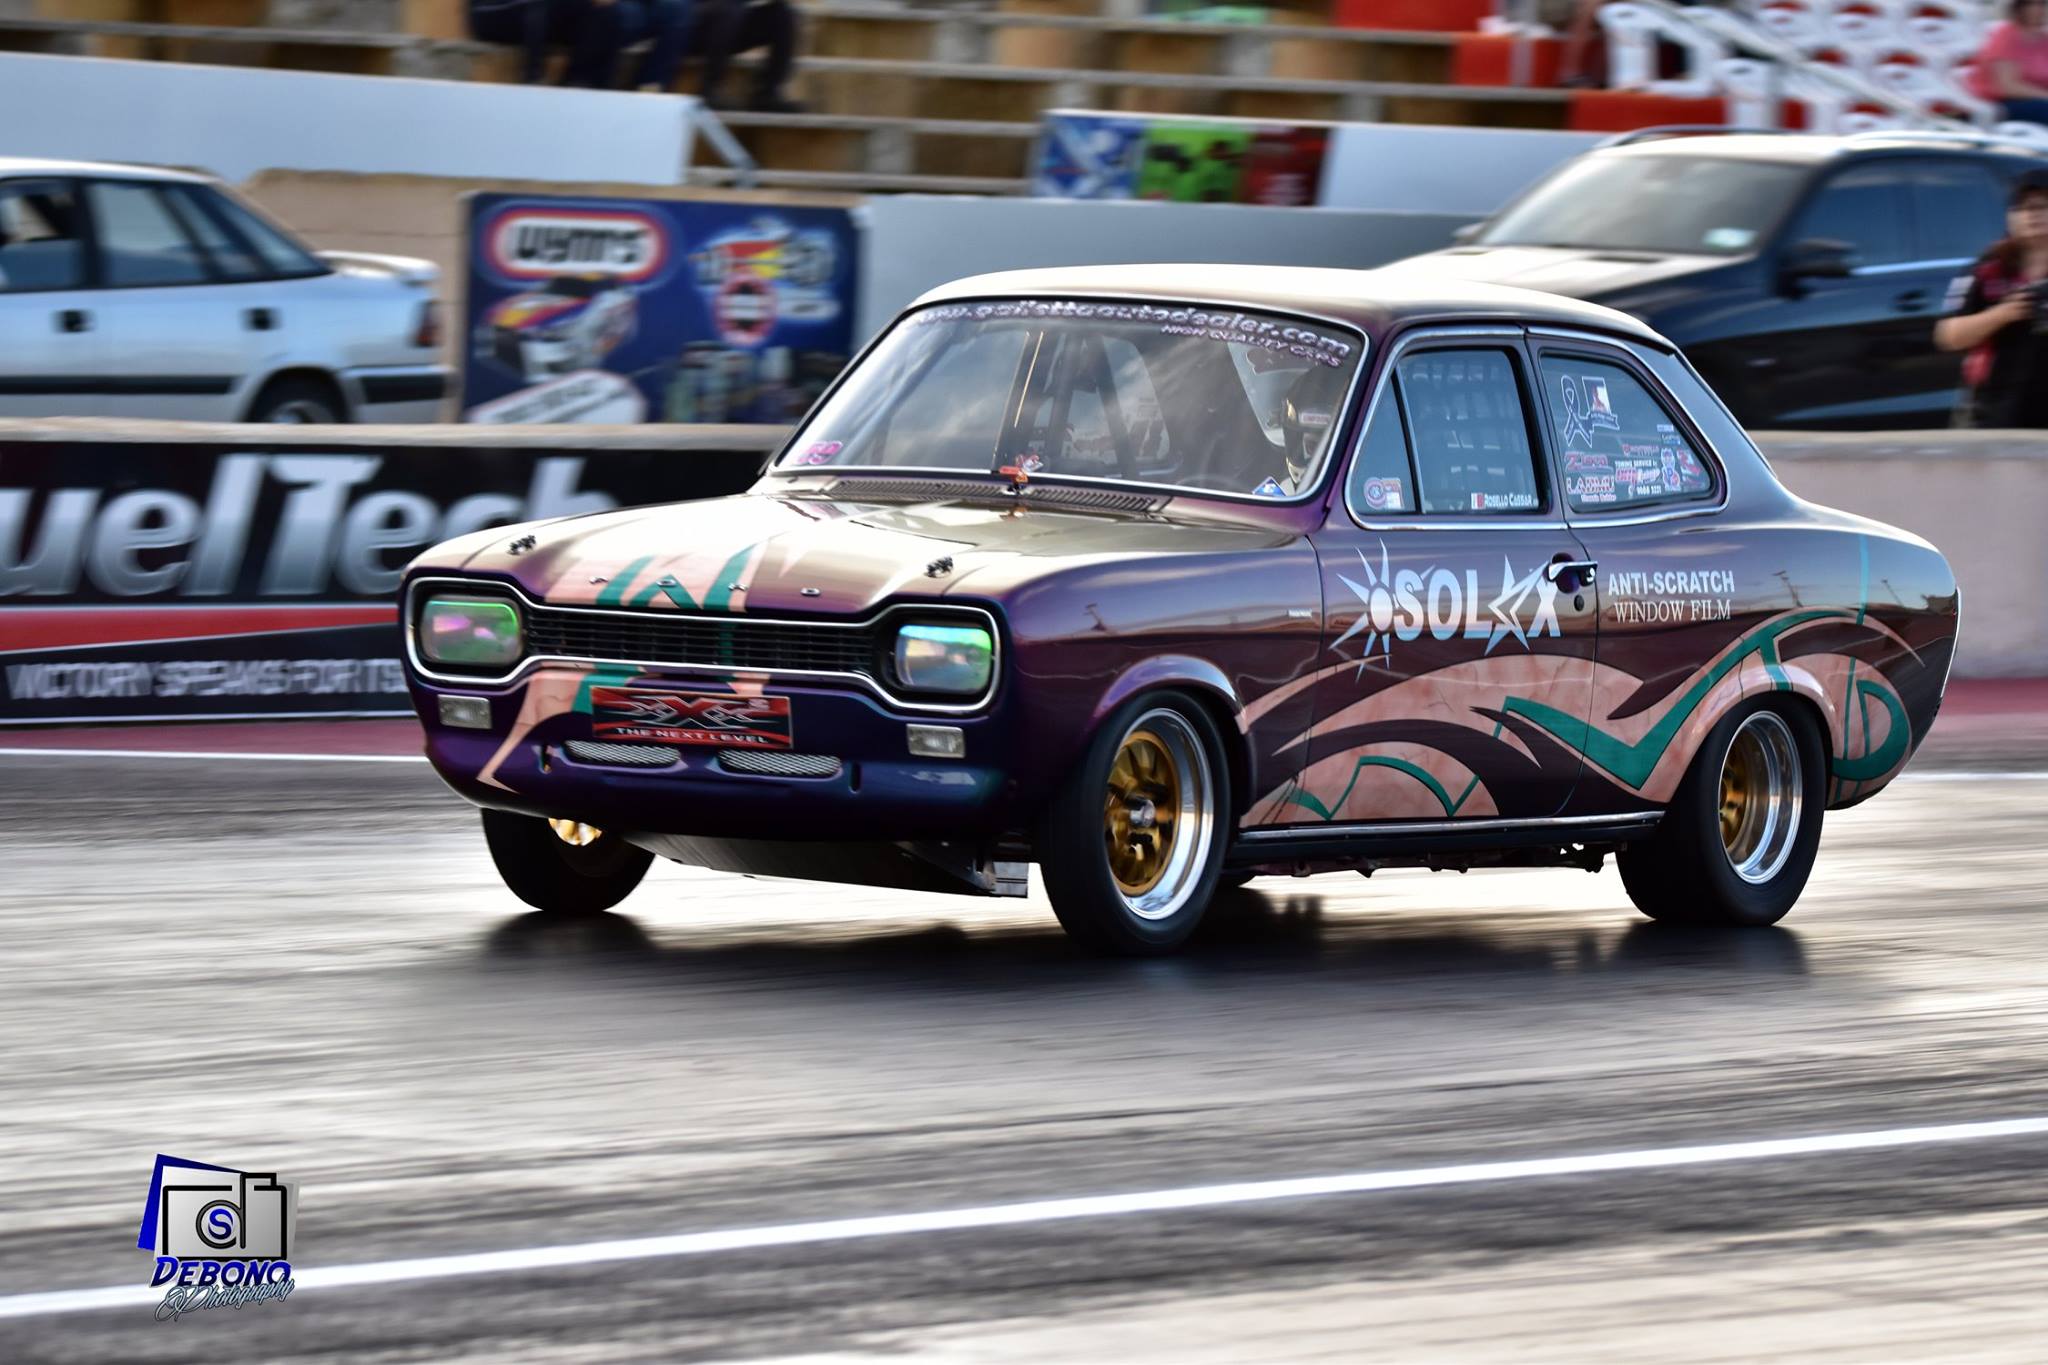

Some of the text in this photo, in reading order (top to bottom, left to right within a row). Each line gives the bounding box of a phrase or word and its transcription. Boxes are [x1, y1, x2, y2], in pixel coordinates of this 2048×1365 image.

[1608, 570, 1736, 596] ANTI-SCRATCH
[1614, 599, 1732, 623] WINDOW FILM
[615, 727, 769, 744] THE NEXT LEVEL
